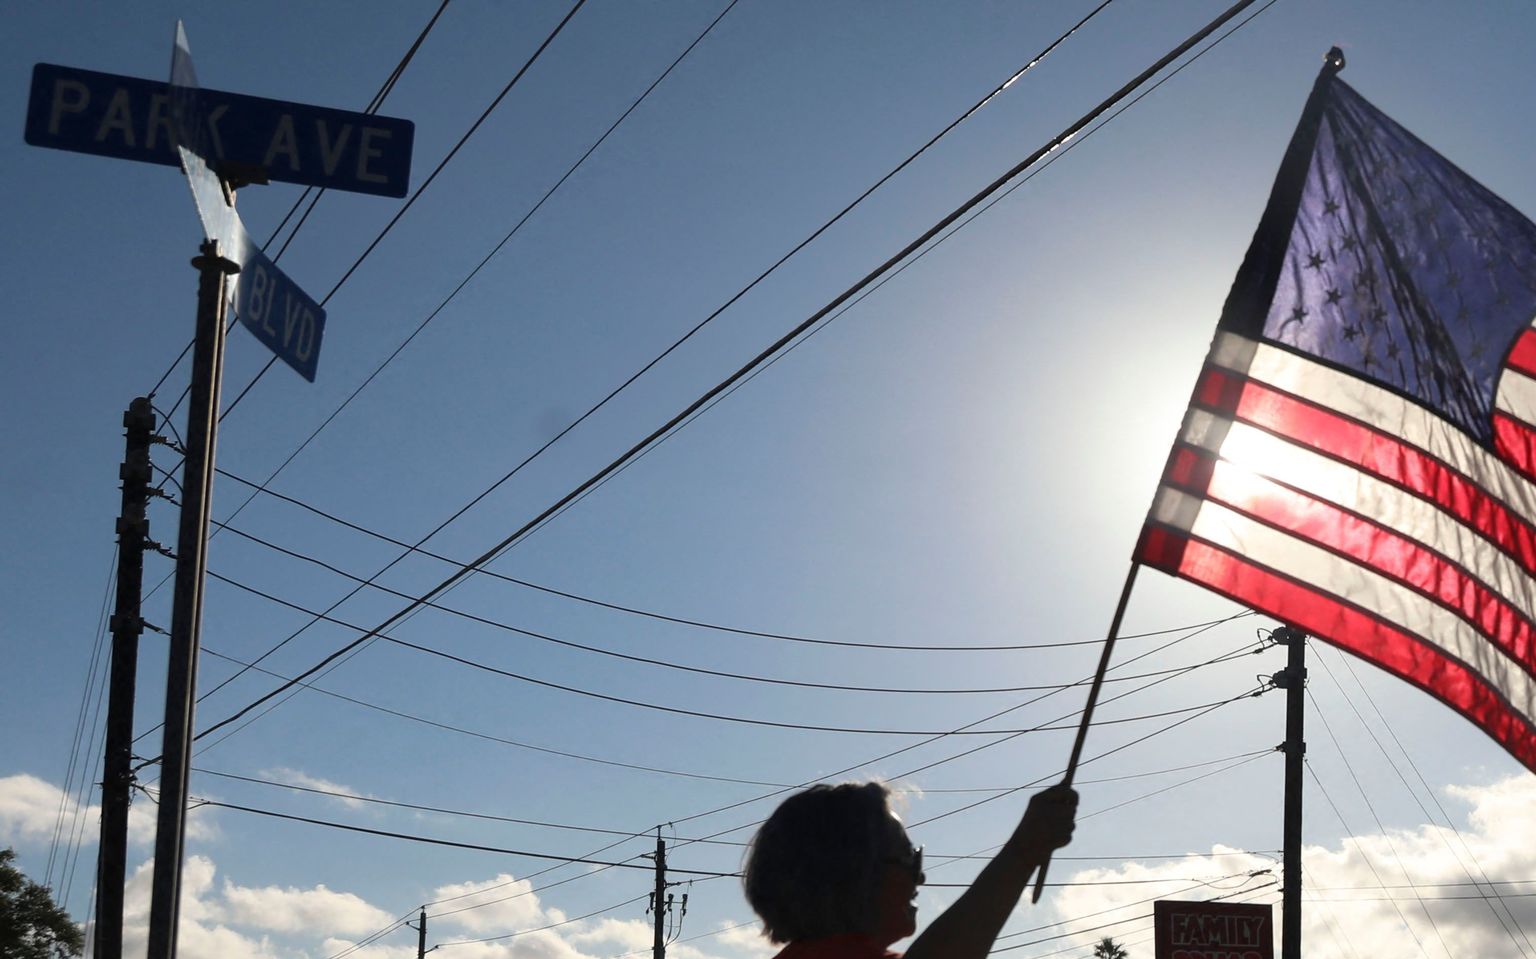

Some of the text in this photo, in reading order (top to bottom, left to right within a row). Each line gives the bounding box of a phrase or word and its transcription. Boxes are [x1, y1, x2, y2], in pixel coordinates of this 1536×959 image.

[262, 114, 393, 184] AVE
[248, 265, 315, 363] BLVD
[1171, 913, 1265, 947] FAMILY
